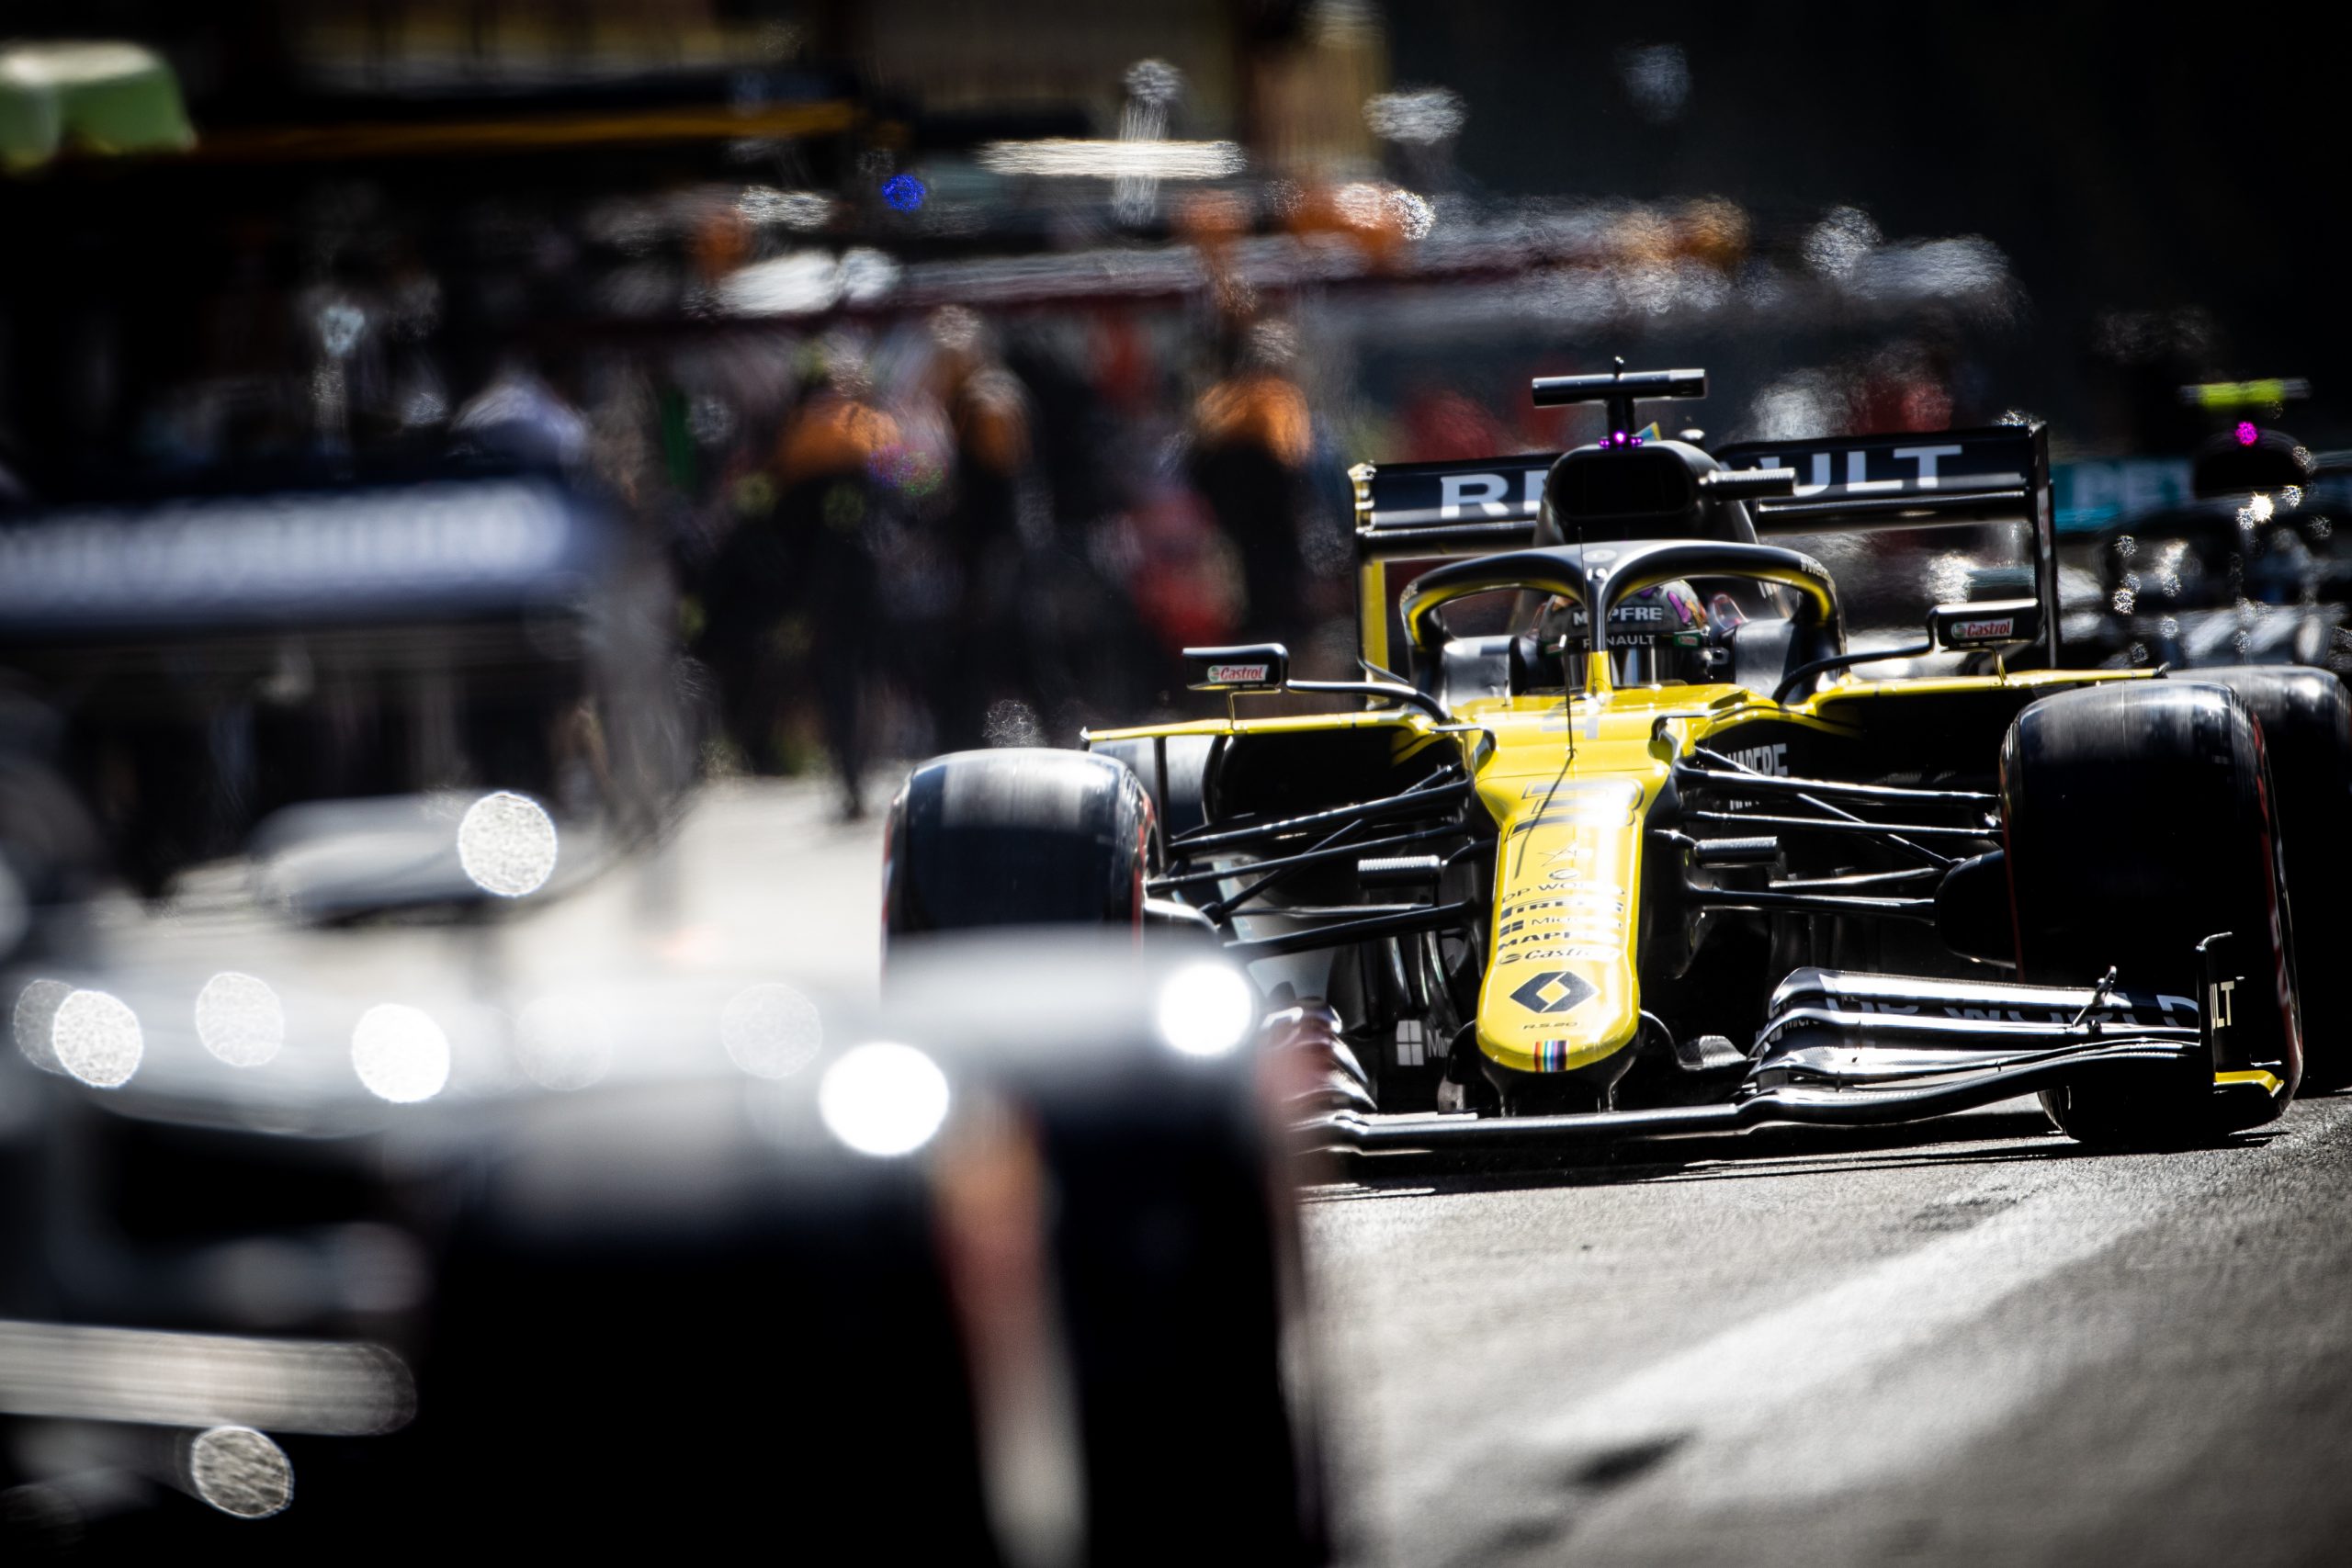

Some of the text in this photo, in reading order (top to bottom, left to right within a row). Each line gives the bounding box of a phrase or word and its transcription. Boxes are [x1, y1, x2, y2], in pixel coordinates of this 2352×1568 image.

[1573, 606, 1664, 626] MPFRE
[1967, 621, 2011, 637] Castrol
[1583, 635, 1657, 649] RNAULT
[1220, 666, 1263, 681] Castrol
[1502, 887, 1532, 904] DP
